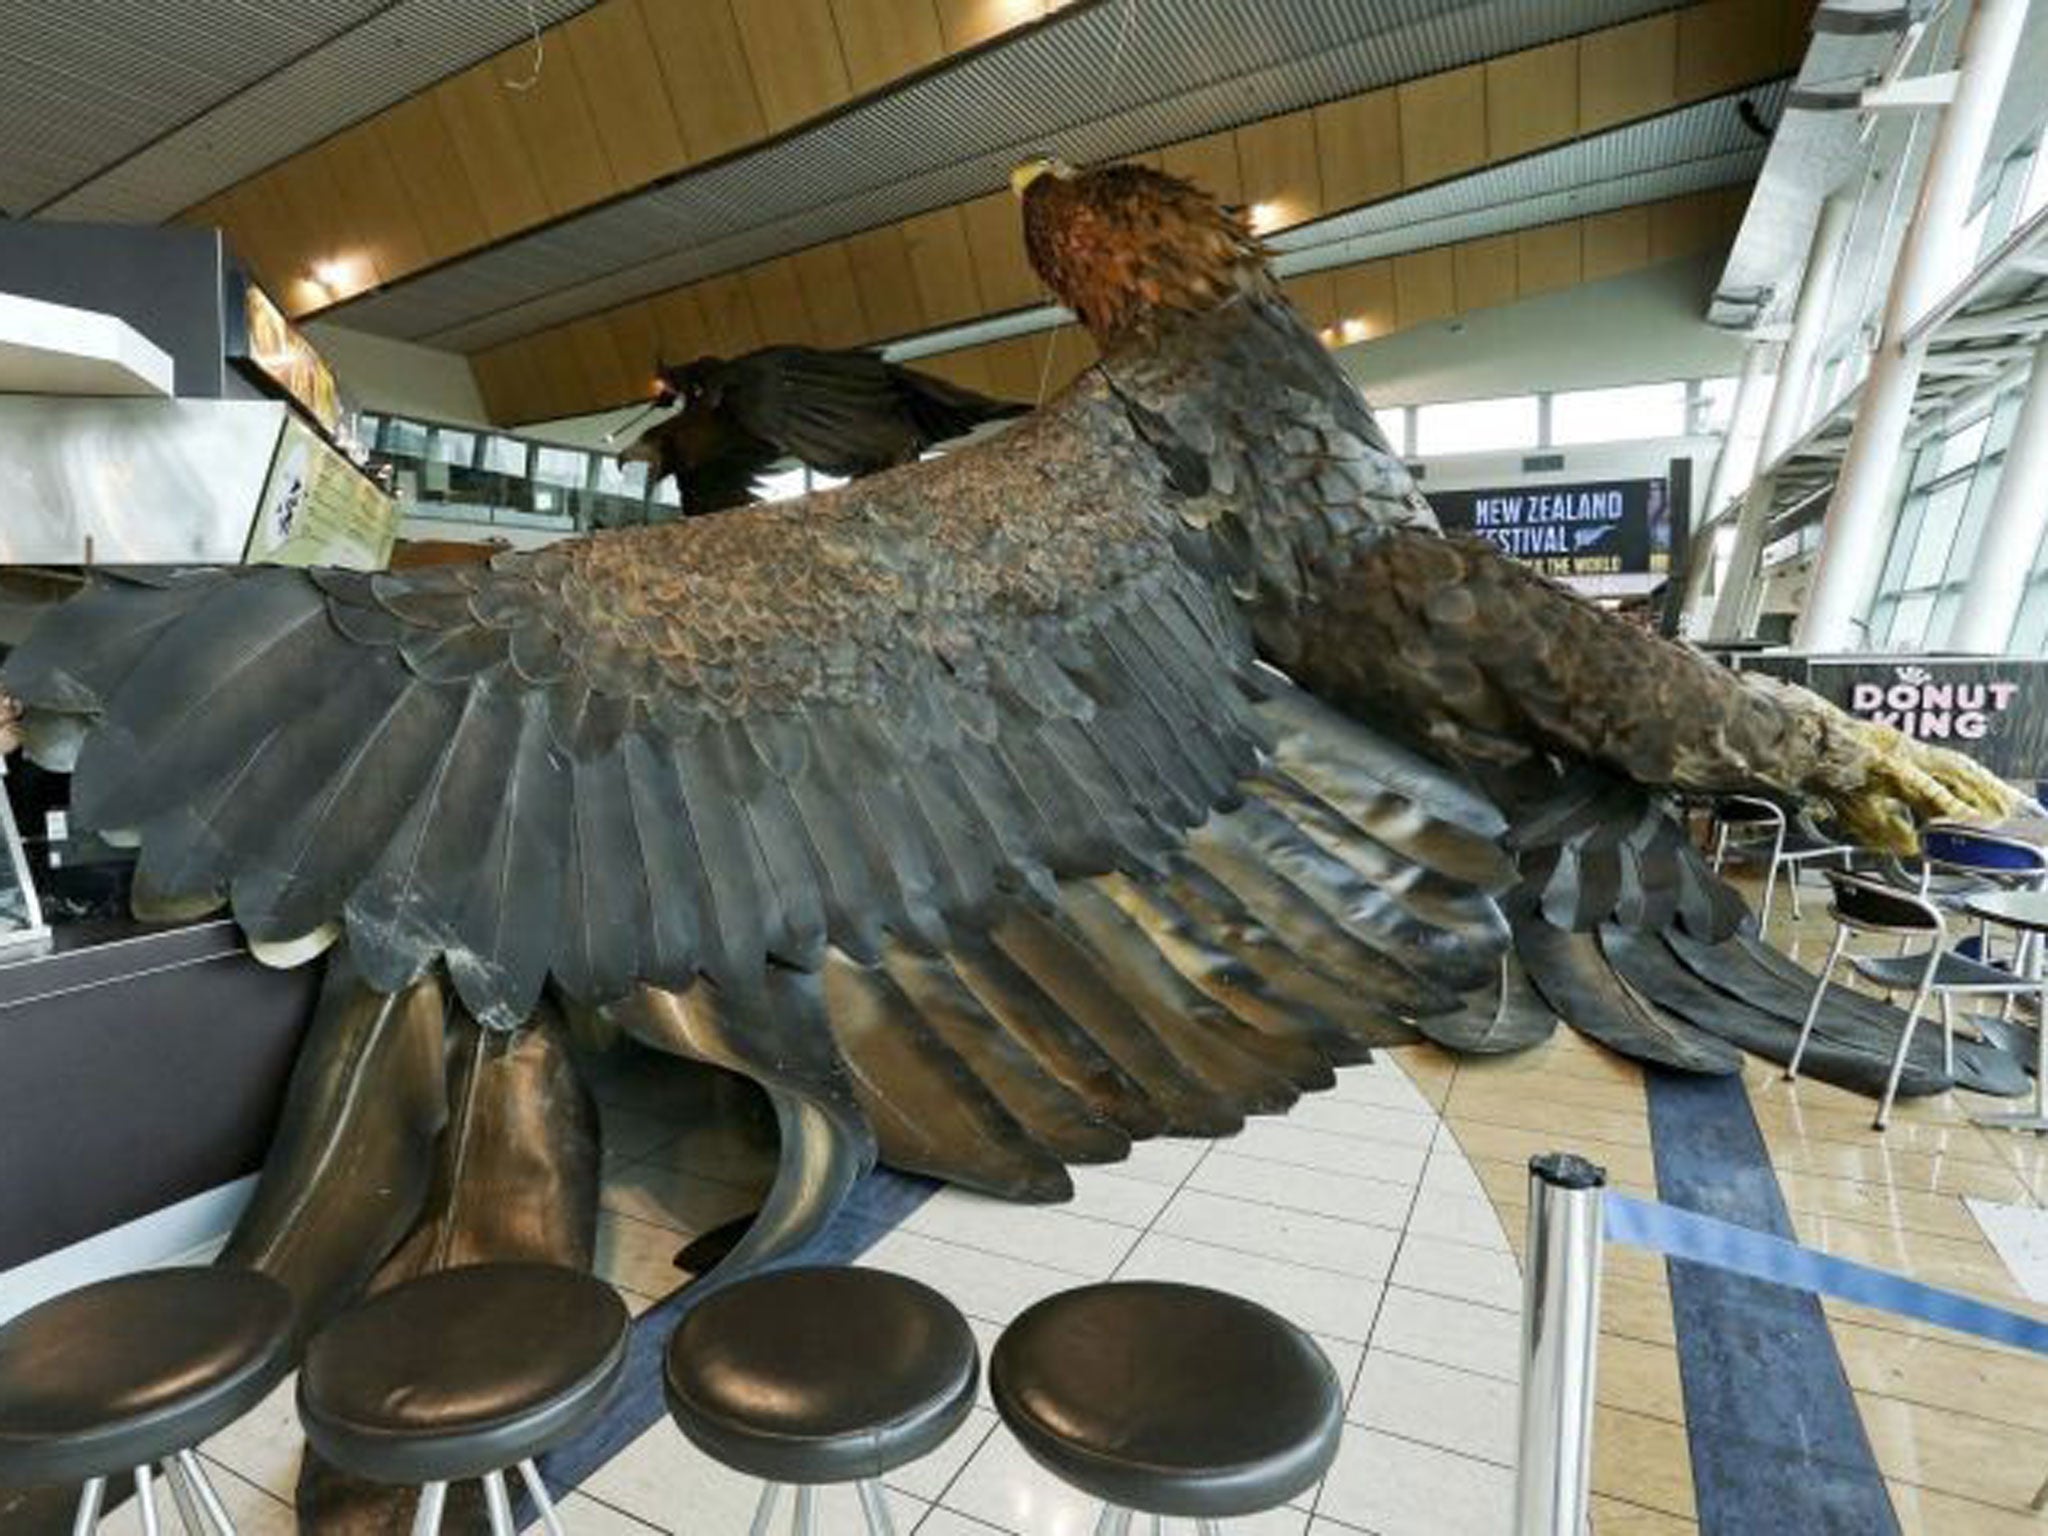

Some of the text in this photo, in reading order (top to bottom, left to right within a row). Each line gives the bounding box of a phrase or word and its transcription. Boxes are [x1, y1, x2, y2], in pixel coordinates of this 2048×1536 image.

[1476, 490, 1623, 526] NEW ZEALAND
[1573, 555, 1622, 573] WORLD
[1852, 683, 2019, 710] DONUT
